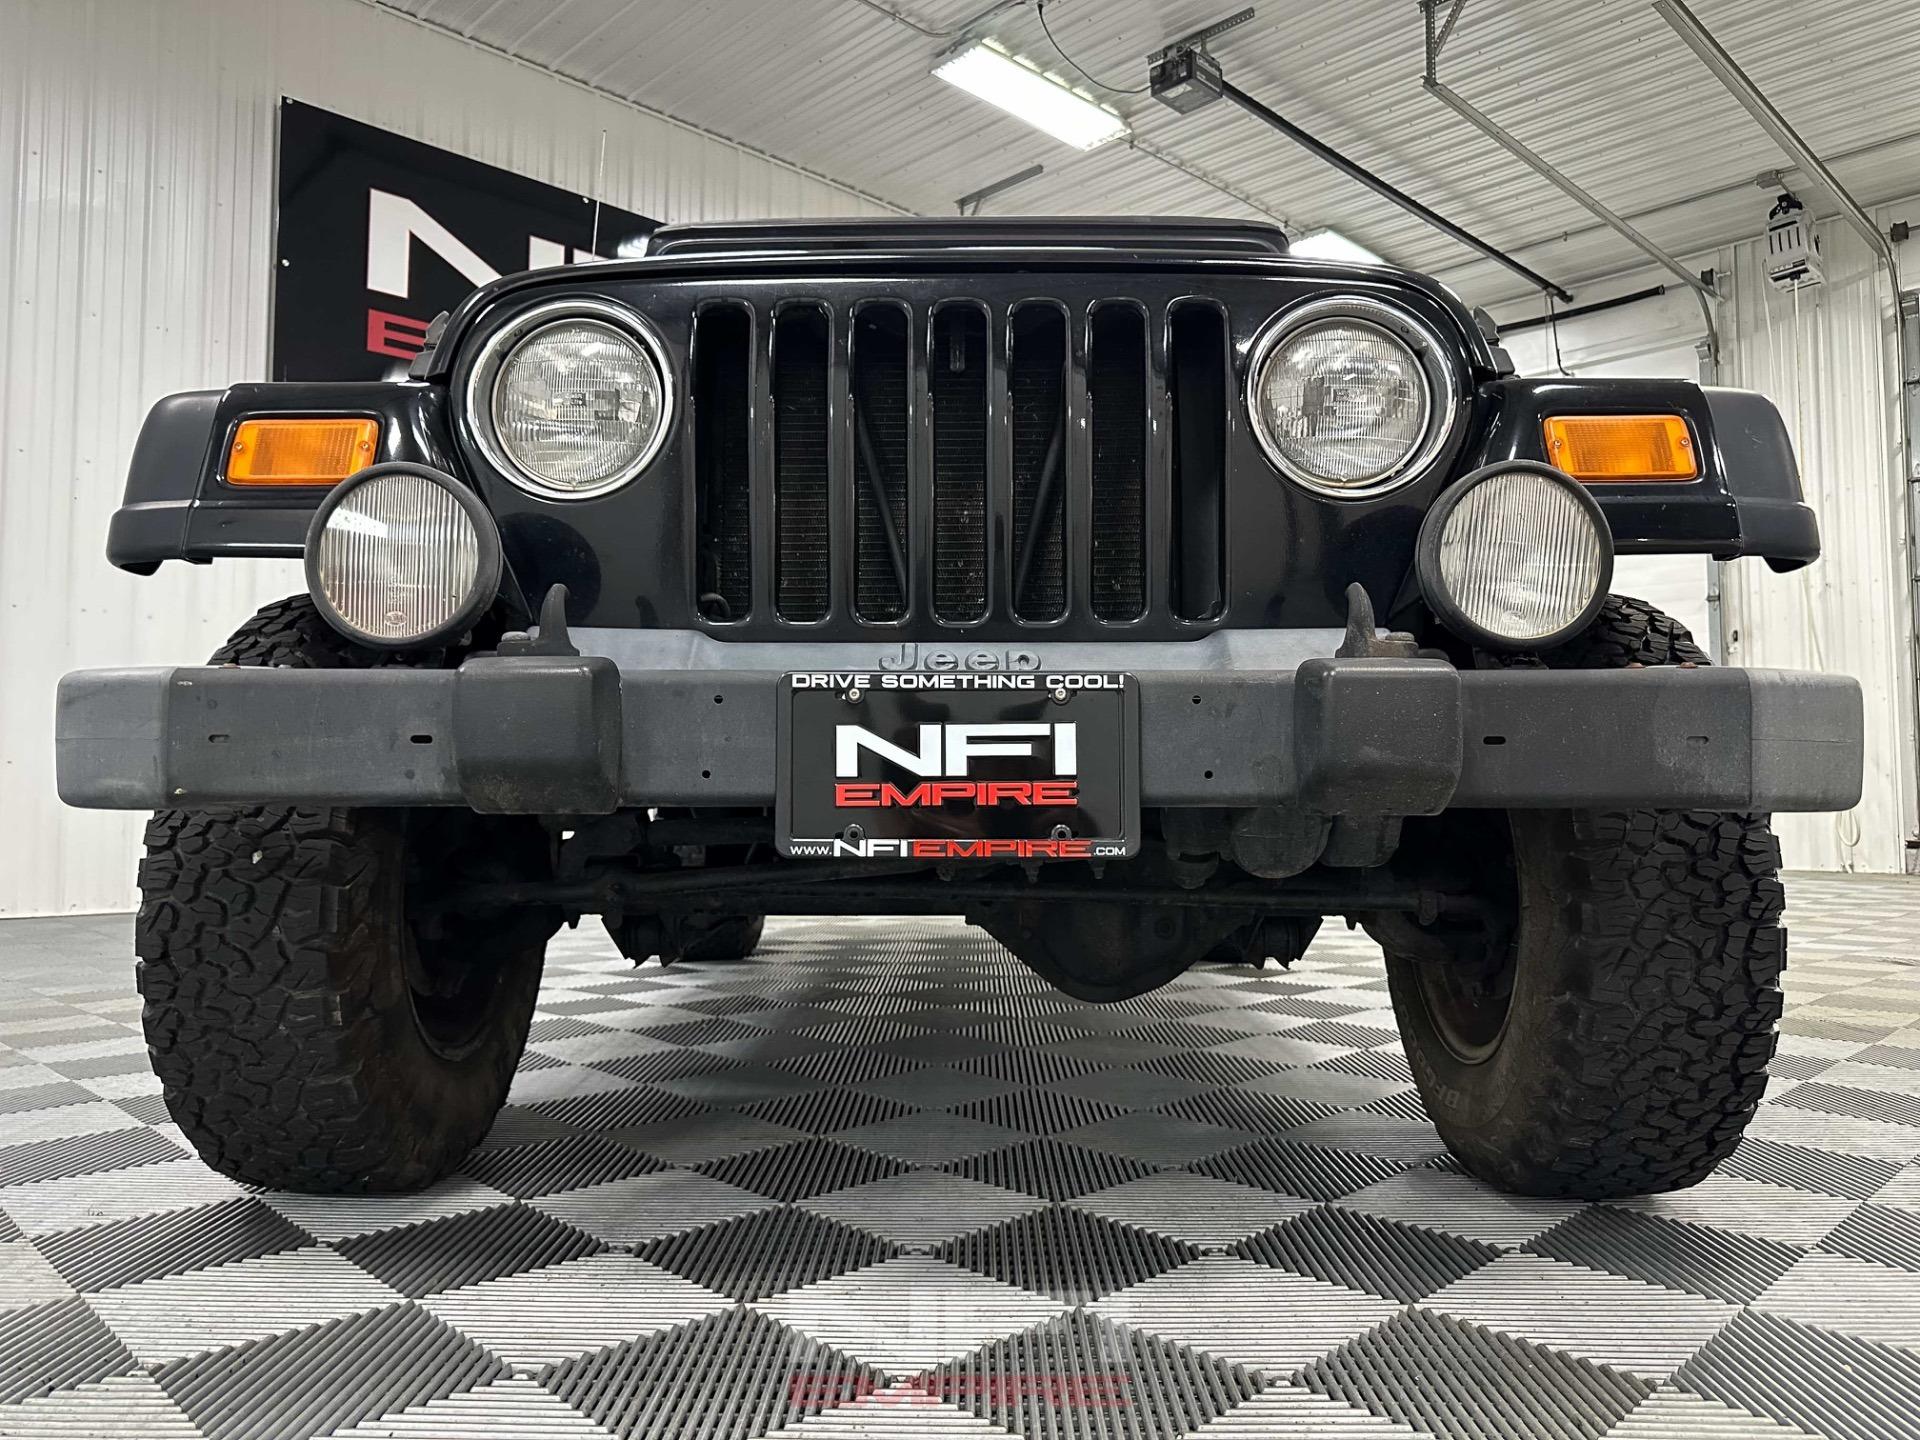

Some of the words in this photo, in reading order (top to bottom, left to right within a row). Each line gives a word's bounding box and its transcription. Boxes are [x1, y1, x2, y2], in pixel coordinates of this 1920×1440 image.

[879, 643, 1042, 671] Jeep
[792, 674, 871, 689] DRIVE
[881, 674, 1035, 689] SOMETHING
[1046, 674, 1125, 690] COOL!
[835, 722, 1077, 777] NFI
[835, 782, 1078, 807] EMPIRE
